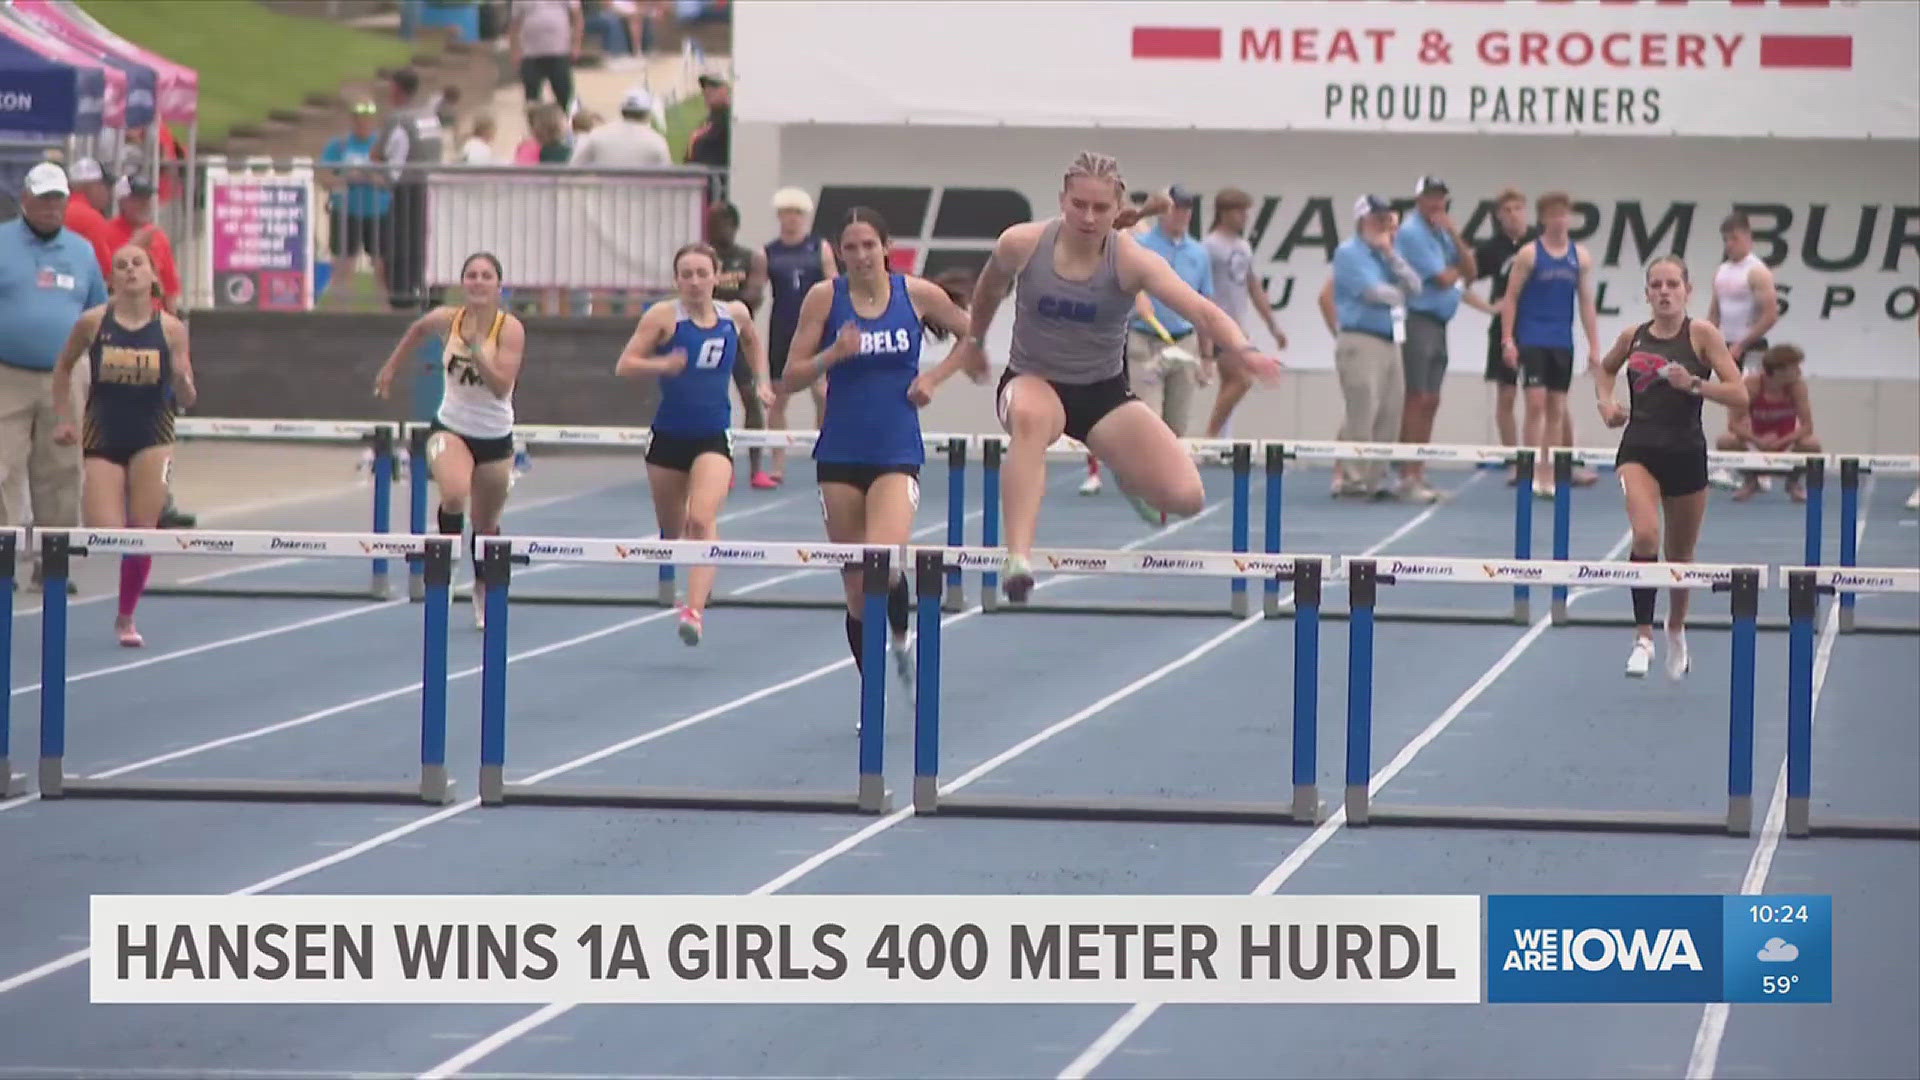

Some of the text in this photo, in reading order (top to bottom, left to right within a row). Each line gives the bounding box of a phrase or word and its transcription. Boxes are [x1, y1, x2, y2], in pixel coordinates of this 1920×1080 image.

[1240, 28, 1745, 67] MEAT & GROCERY
[1325, 84, 1661, 124] PROUD PARTNERS
[696, 338, 726, 369] G
[87, 534, 118, 546] Drake
[270, 538, 301, 549] Drake
[528, 542, 558, 554] Drake
[709, 545, 740, 558] Drake
[957, 552, 991, 565] Drake
[1142, 555, 1176, 568] Drake
[1391, 561, 1425, 574] Drake
[1577, 565, 1612, 578] Drake
[1831, 572, 1865, 586] Drake
